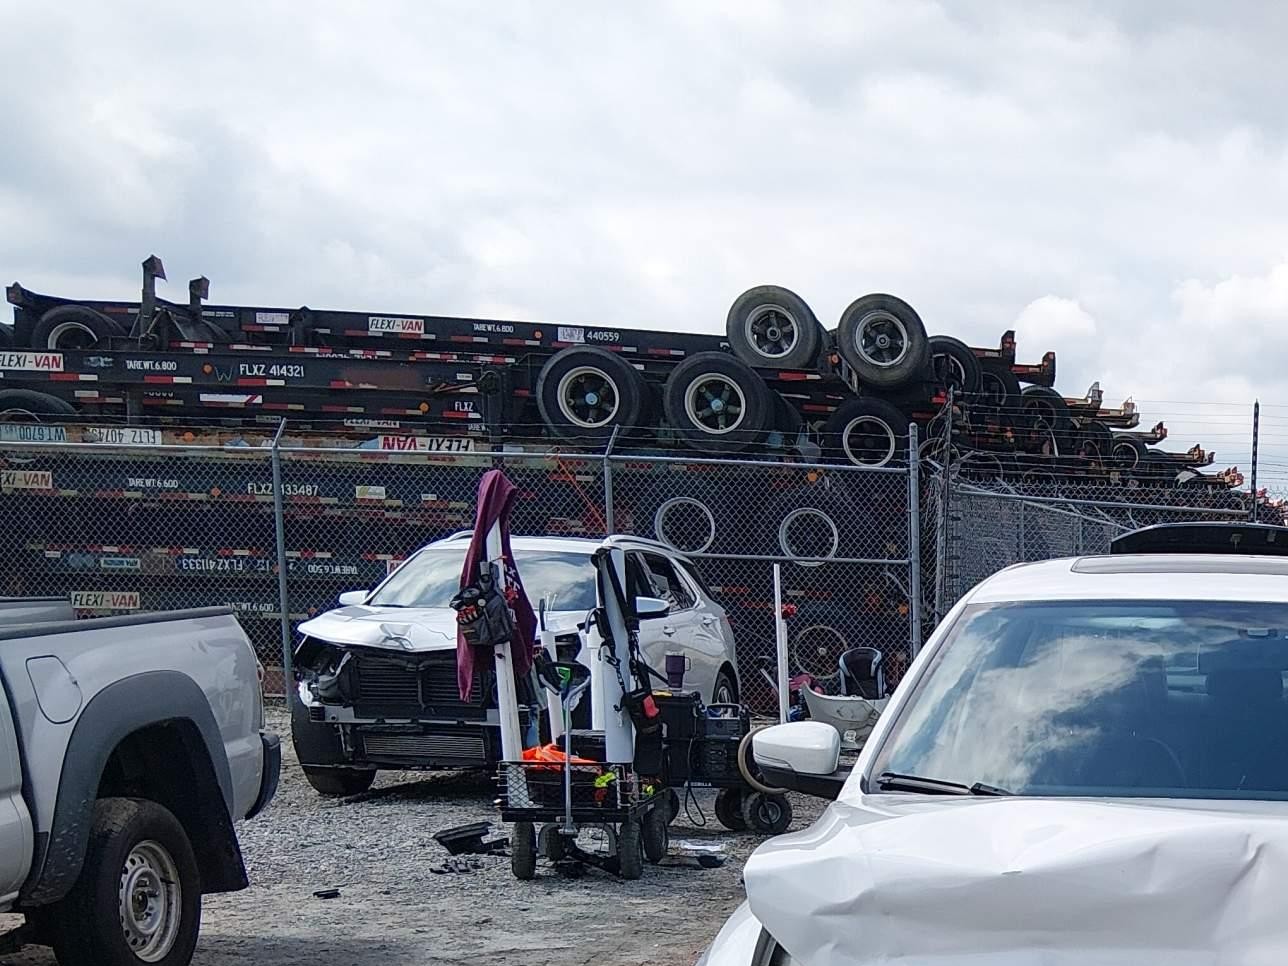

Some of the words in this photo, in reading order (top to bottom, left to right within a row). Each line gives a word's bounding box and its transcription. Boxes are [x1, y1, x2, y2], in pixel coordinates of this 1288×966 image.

[370, 318, 423, 332] FLEXI-VAN
[587, 331, 620, 342] 440559
[239, 363, 266, 376] FLXZ
[269, 364, 305, 377] 414321
[455, 401, 474, 412] FLXZ
[247, 482, 273, 495] FLXZ
[280, 484, 319, 496] 133487
[73, 593, 139, 608] FLEXI-VAN
